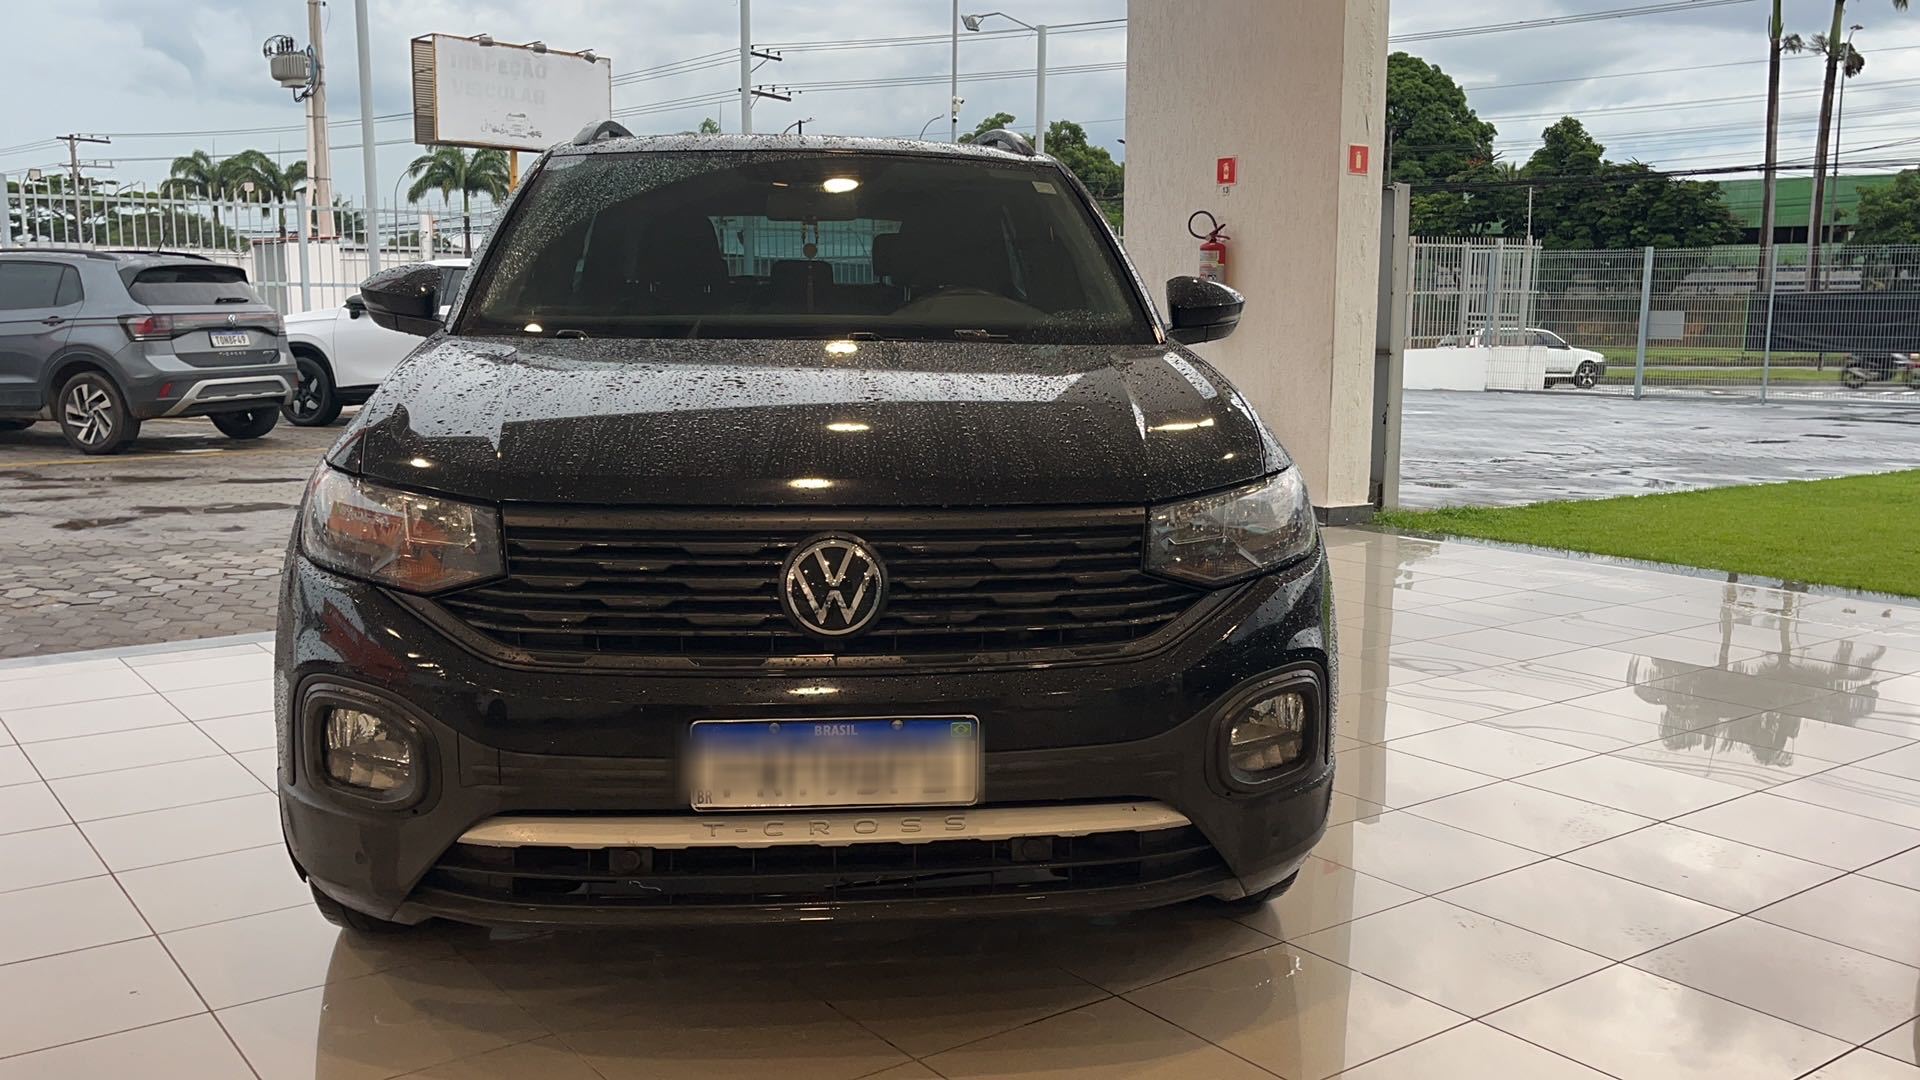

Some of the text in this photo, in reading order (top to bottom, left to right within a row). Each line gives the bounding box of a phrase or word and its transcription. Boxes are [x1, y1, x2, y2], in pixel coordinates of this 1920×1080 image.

[792, 544, 877, 626] VW
[814, 724, 858, 737] BRASIL
[697, 791, 713, 805] BR
[702, 816, 967, 838] T-CROSS
